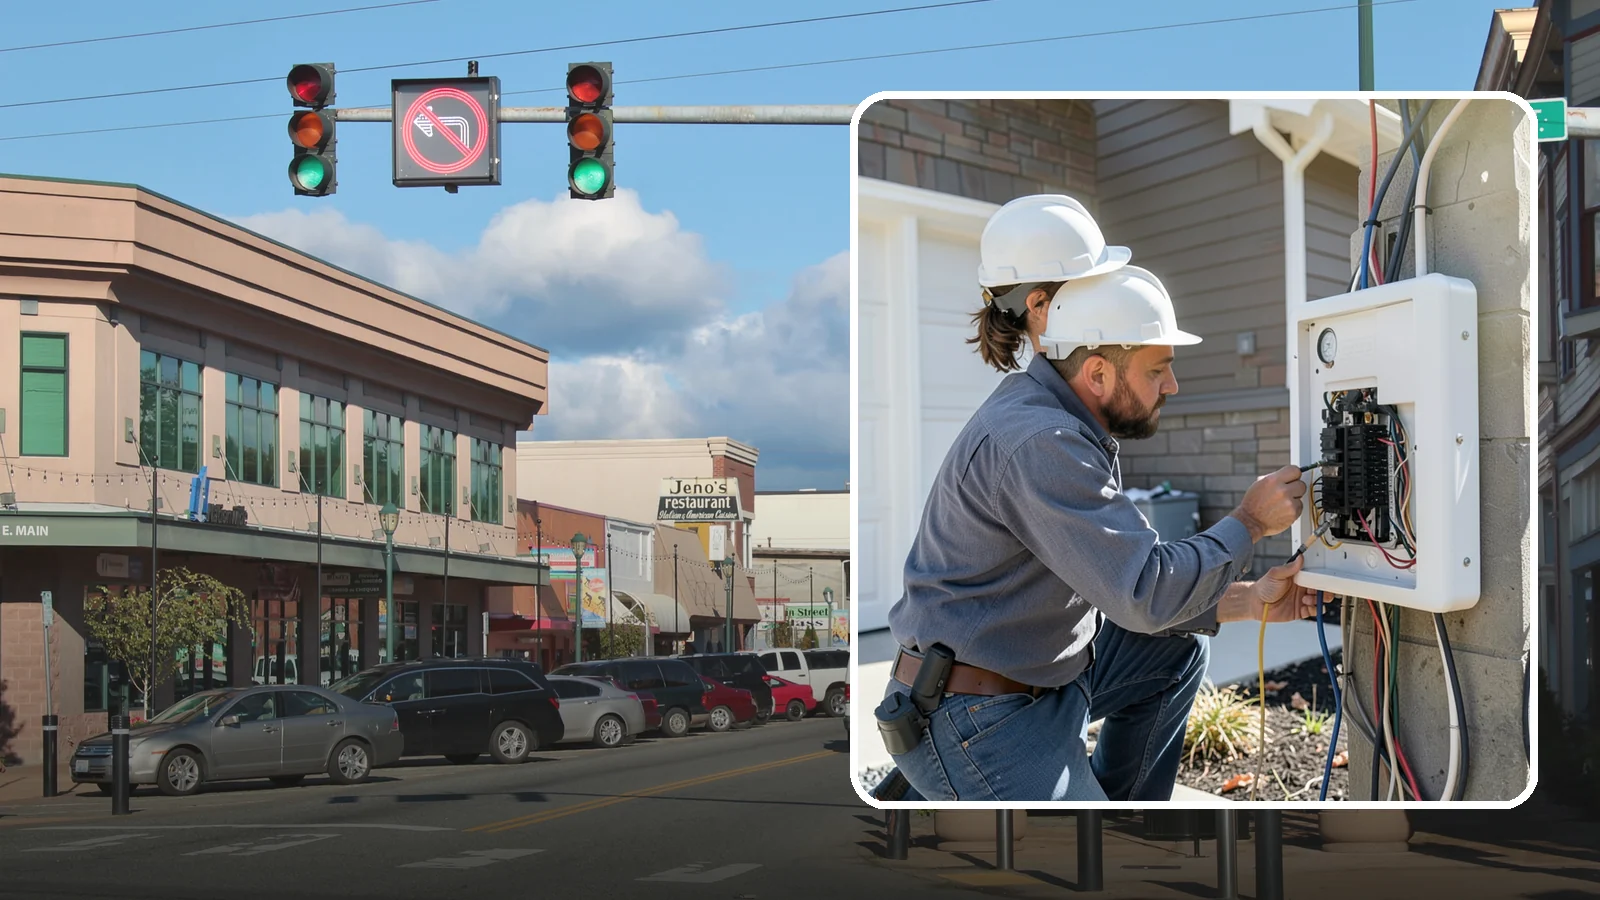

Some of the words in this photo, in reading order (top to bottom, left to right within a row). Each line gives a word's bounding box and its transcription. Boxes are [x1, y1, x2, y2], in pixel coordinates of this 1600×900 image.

[670, 480, 727, 495] Jeno's
[665, 496, 731, 509] restaurant
[658, 509, 681, 519] Italian
[686, 509, 714, 519] American
[714, 509, 738, 519] Cuisine
[2, 525, 13, 536] E.
[15, 525, 49, 536] MAIN
[797, 607, 829, 617] Street
